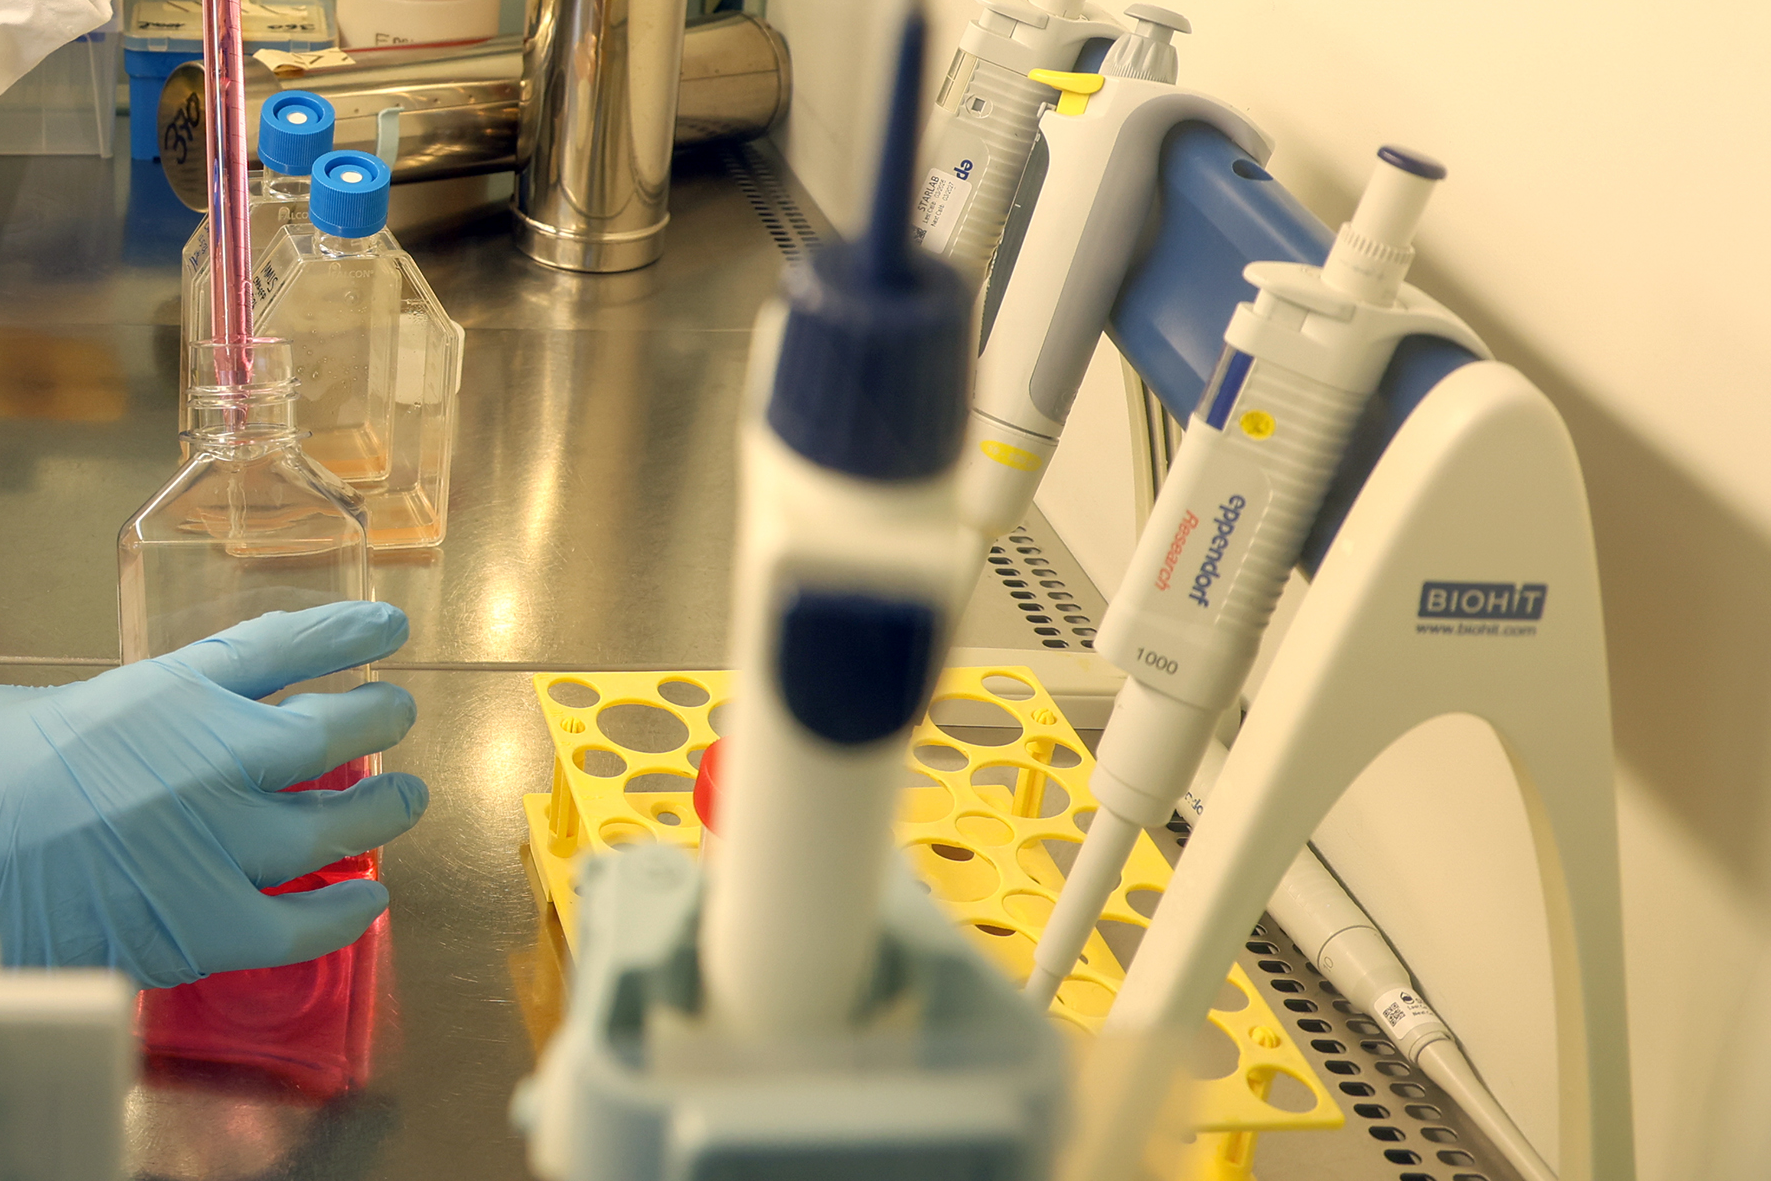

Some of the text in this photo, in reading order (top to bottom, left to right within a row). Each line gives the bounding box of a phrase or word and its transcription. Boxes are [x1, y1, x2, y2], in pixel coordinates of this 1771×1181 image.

[917, 175, 940, 213] STARLAB
[280, 210, 308, 221] FALCO
[1154, 509, 1200, 592] Research
[1188, 494, 1246, 608] eppendorf
[1424, 582, 1544, 617] BIOHIT
[1416, 623, 1537, 636] www.biohit.com
[1135, 646, 1179, 676] 1000
[1322, 956, 1334, 972] 10
